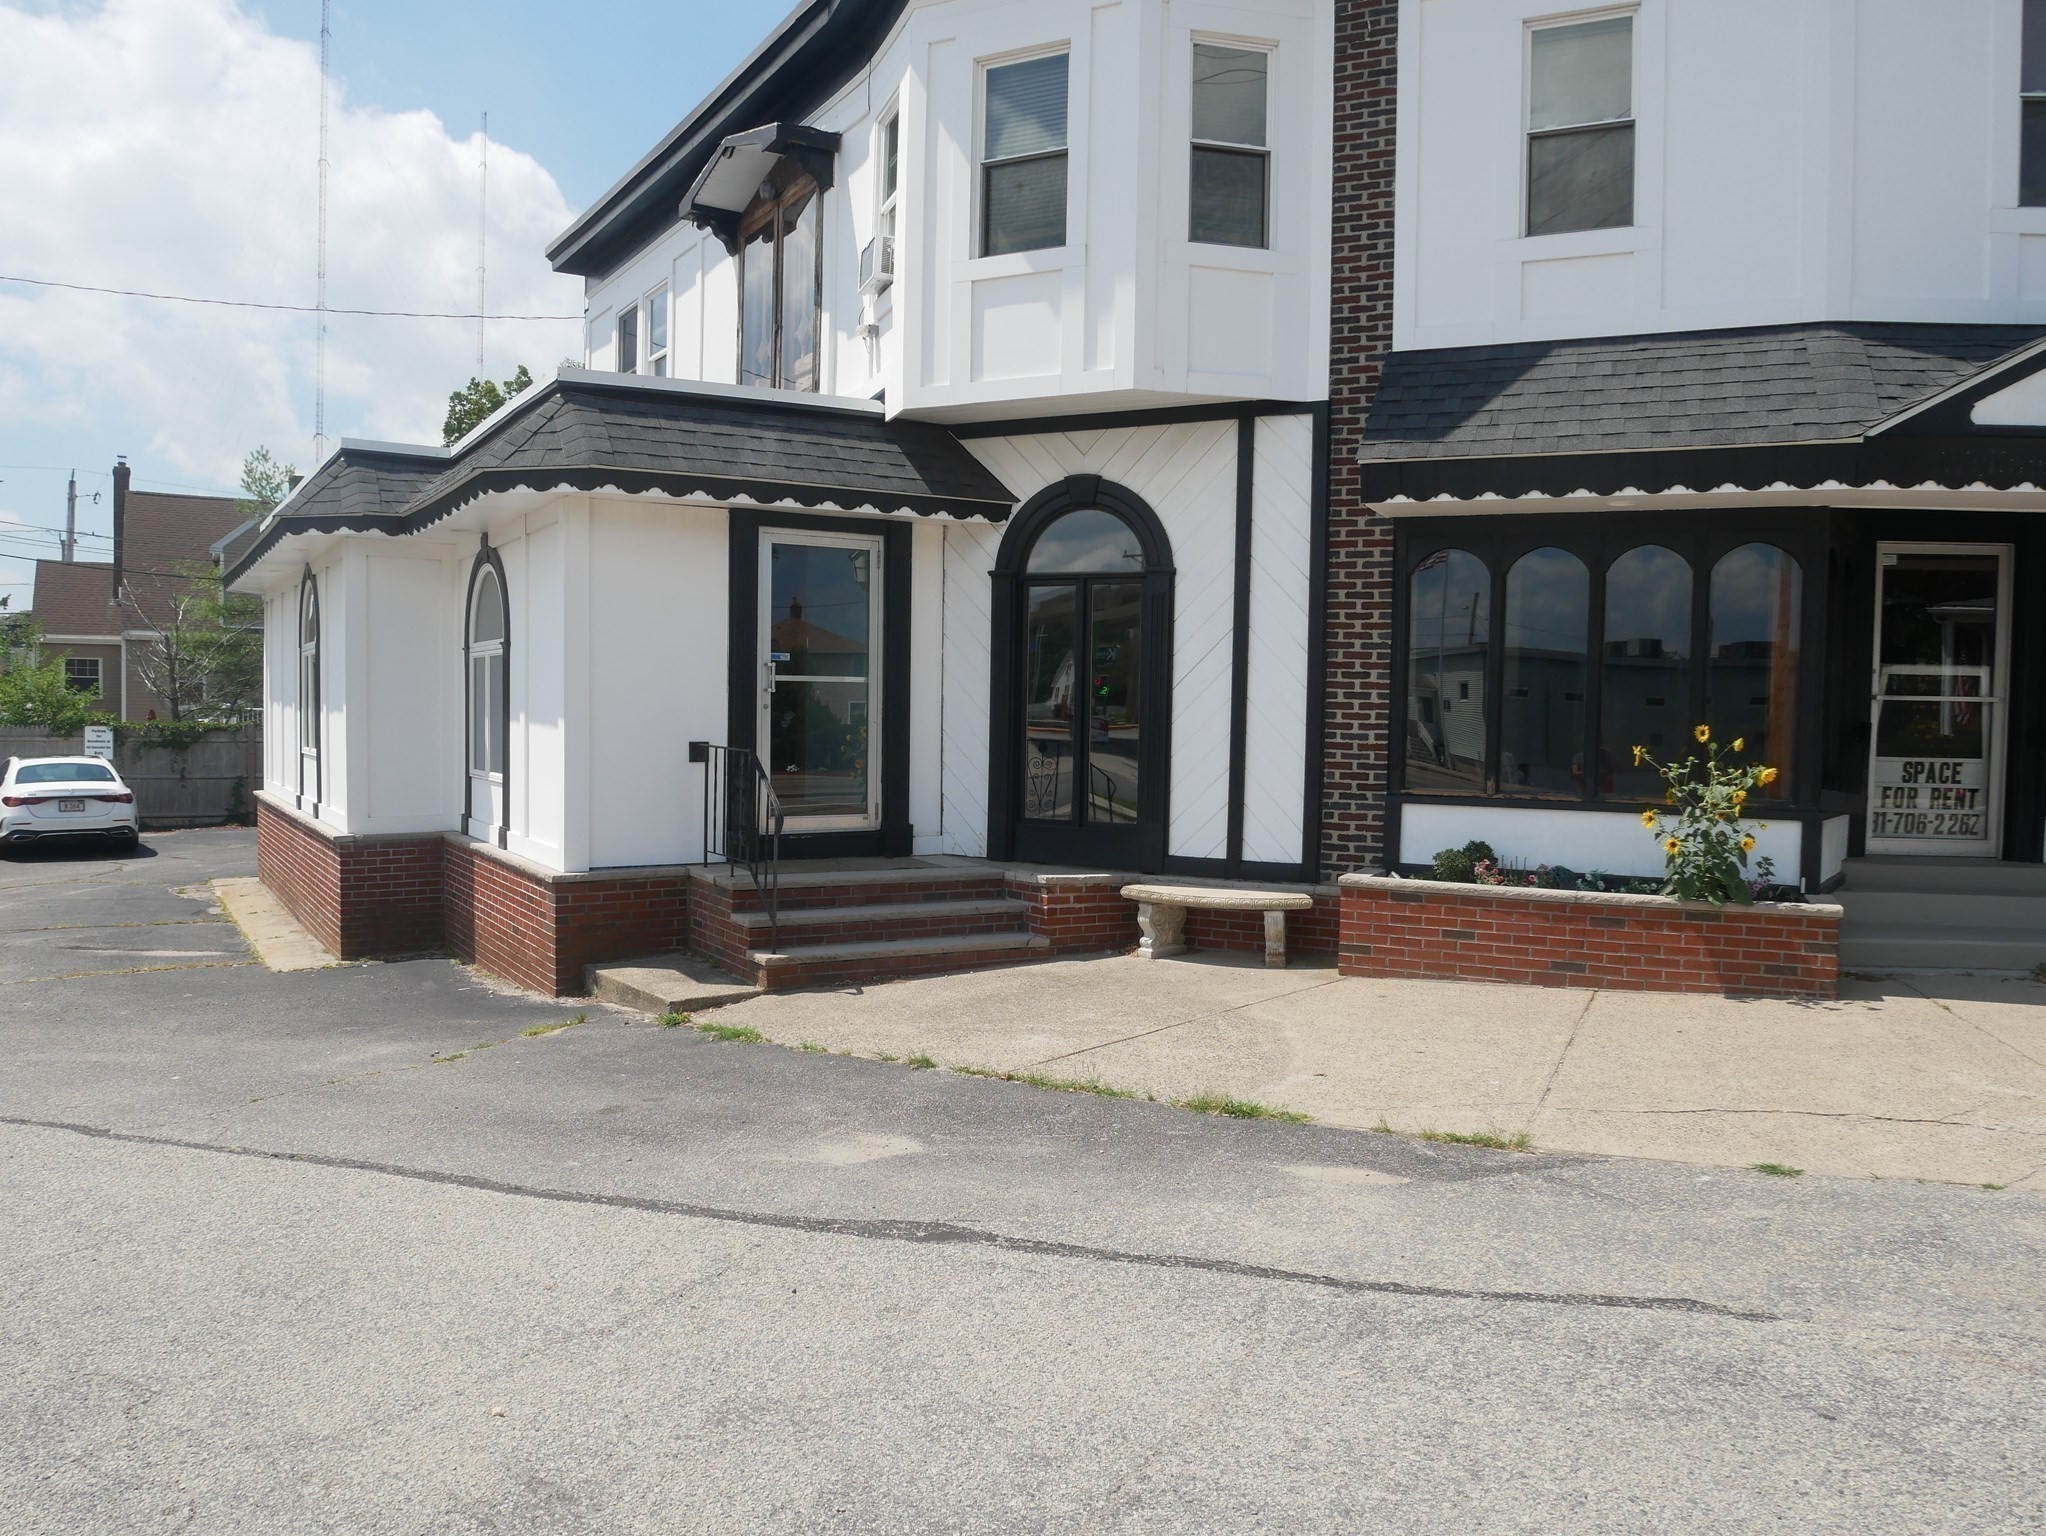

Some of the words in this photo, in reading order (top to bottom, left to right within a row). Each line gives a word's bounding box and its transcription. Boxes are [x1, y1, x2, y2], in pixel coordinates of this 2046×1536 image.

[1901, 761, 1963, 784] SPACE
[1880, 786, 1918, 808] FOR
[1929, 787, 1980, 810] RENT
